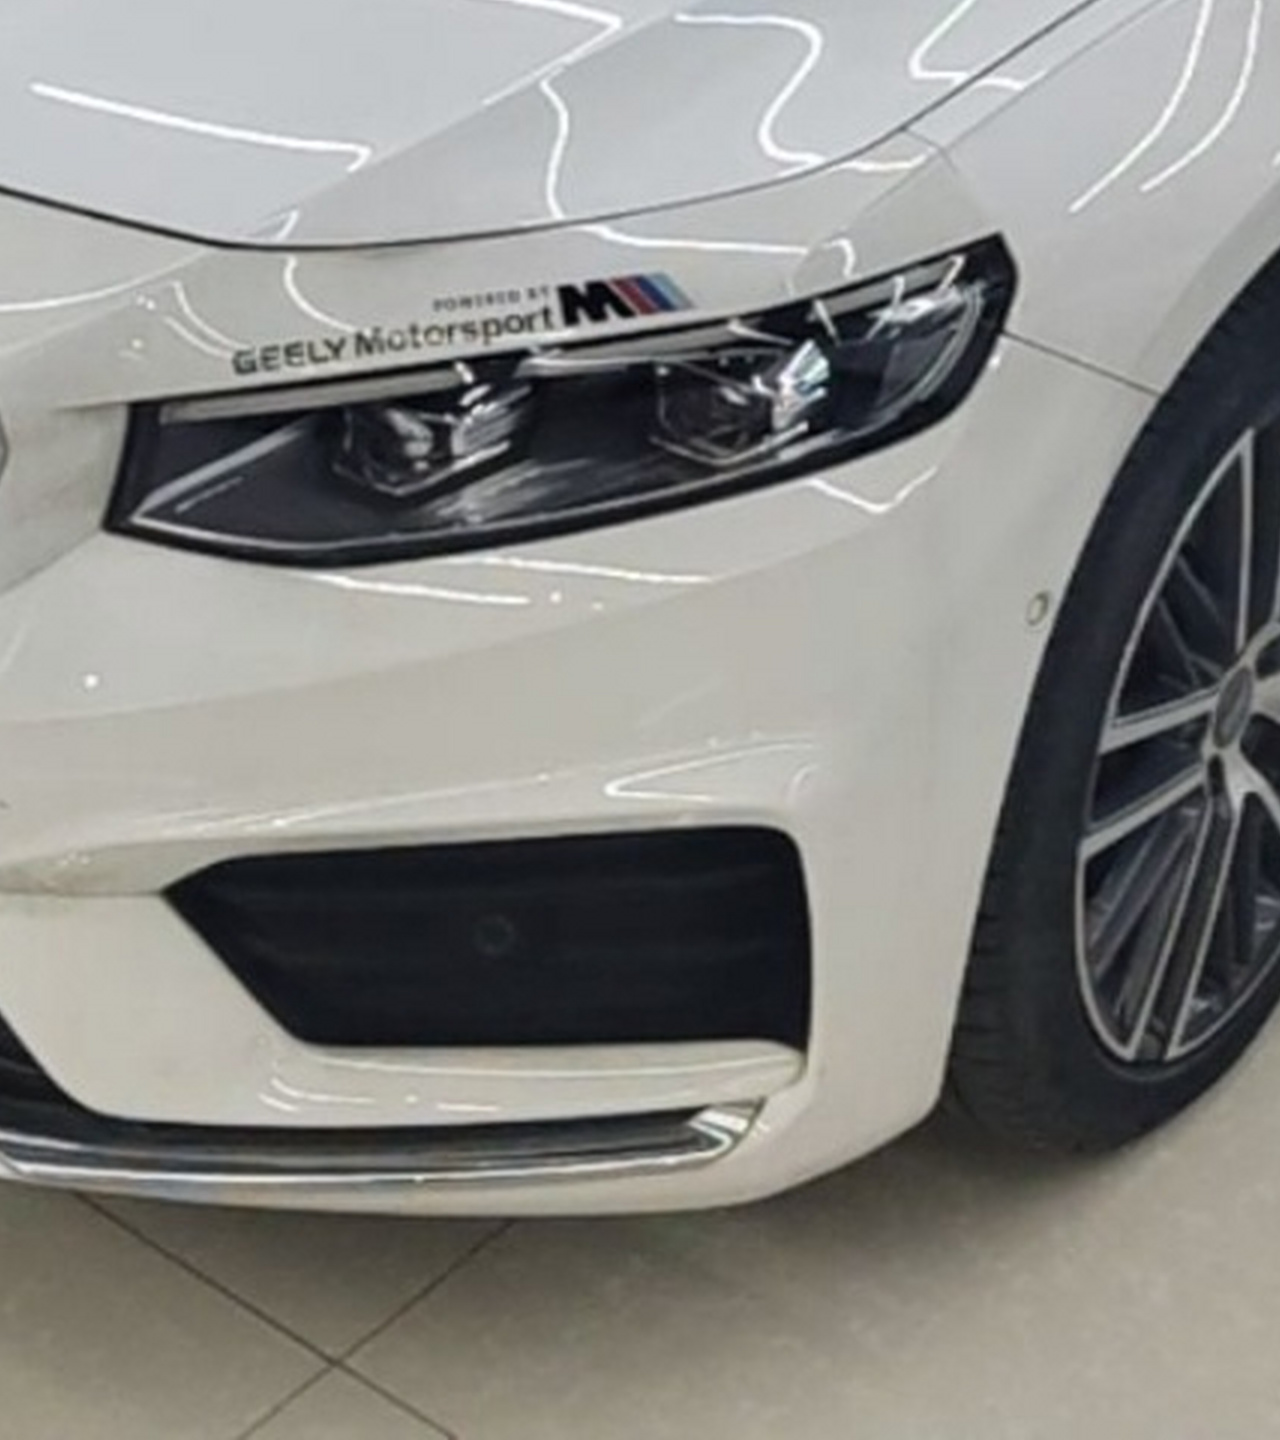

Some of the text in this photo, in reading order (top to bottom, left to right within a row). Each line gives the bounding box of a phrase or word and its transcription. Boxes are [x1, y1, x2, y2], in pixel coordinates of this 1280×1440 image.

[432, 289, 521, 312] POWERED
[231, 305, 555, 376] GEELY Motorsport
